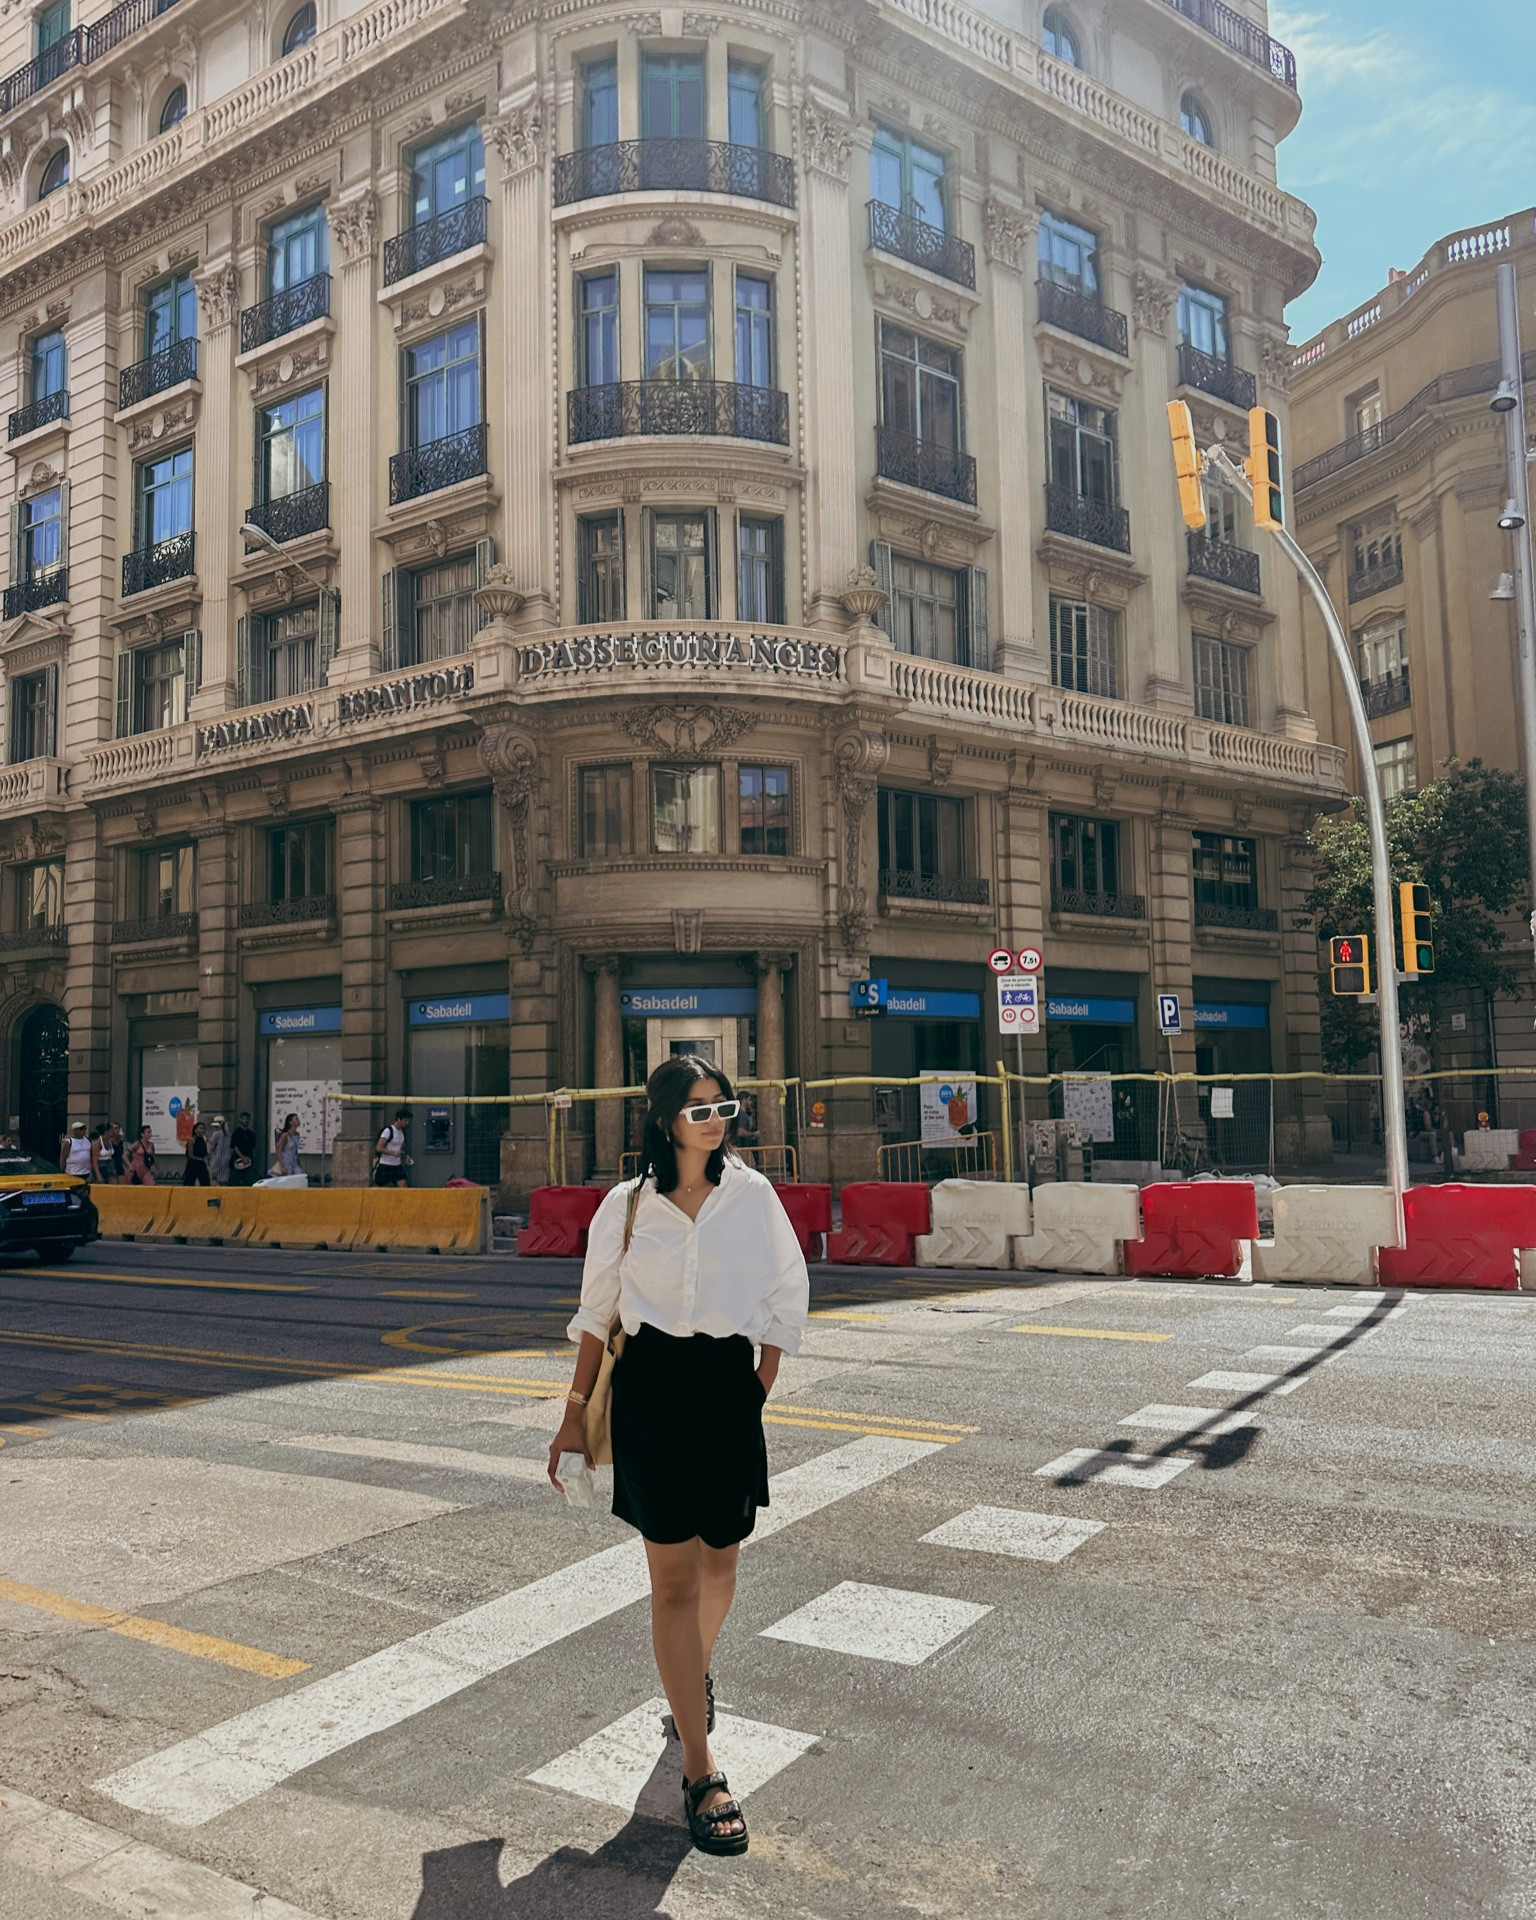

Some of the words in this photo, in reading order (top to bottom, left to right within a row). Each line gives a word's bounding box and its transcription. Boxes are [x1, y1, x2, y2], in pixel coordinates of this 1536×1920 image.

[521, 635, 838, 676] D'ASSEGURANCES
[338, 664, 474, 720] ESPANYOLA
[868, 983, 880, 1006] S
[631, 995, 698, 1010] Sabadell
[887, 997, 926, 1011] abadell
[1049, 1002, 1089, 1016] Sabadell
[426, 1003, 472, 1019] Sabadell
[1163, 998, 1176, 1025] P
[1193, 1010, 1227, 1022] Sabadell
[275, 1015, 315, 1029] Sabadell
